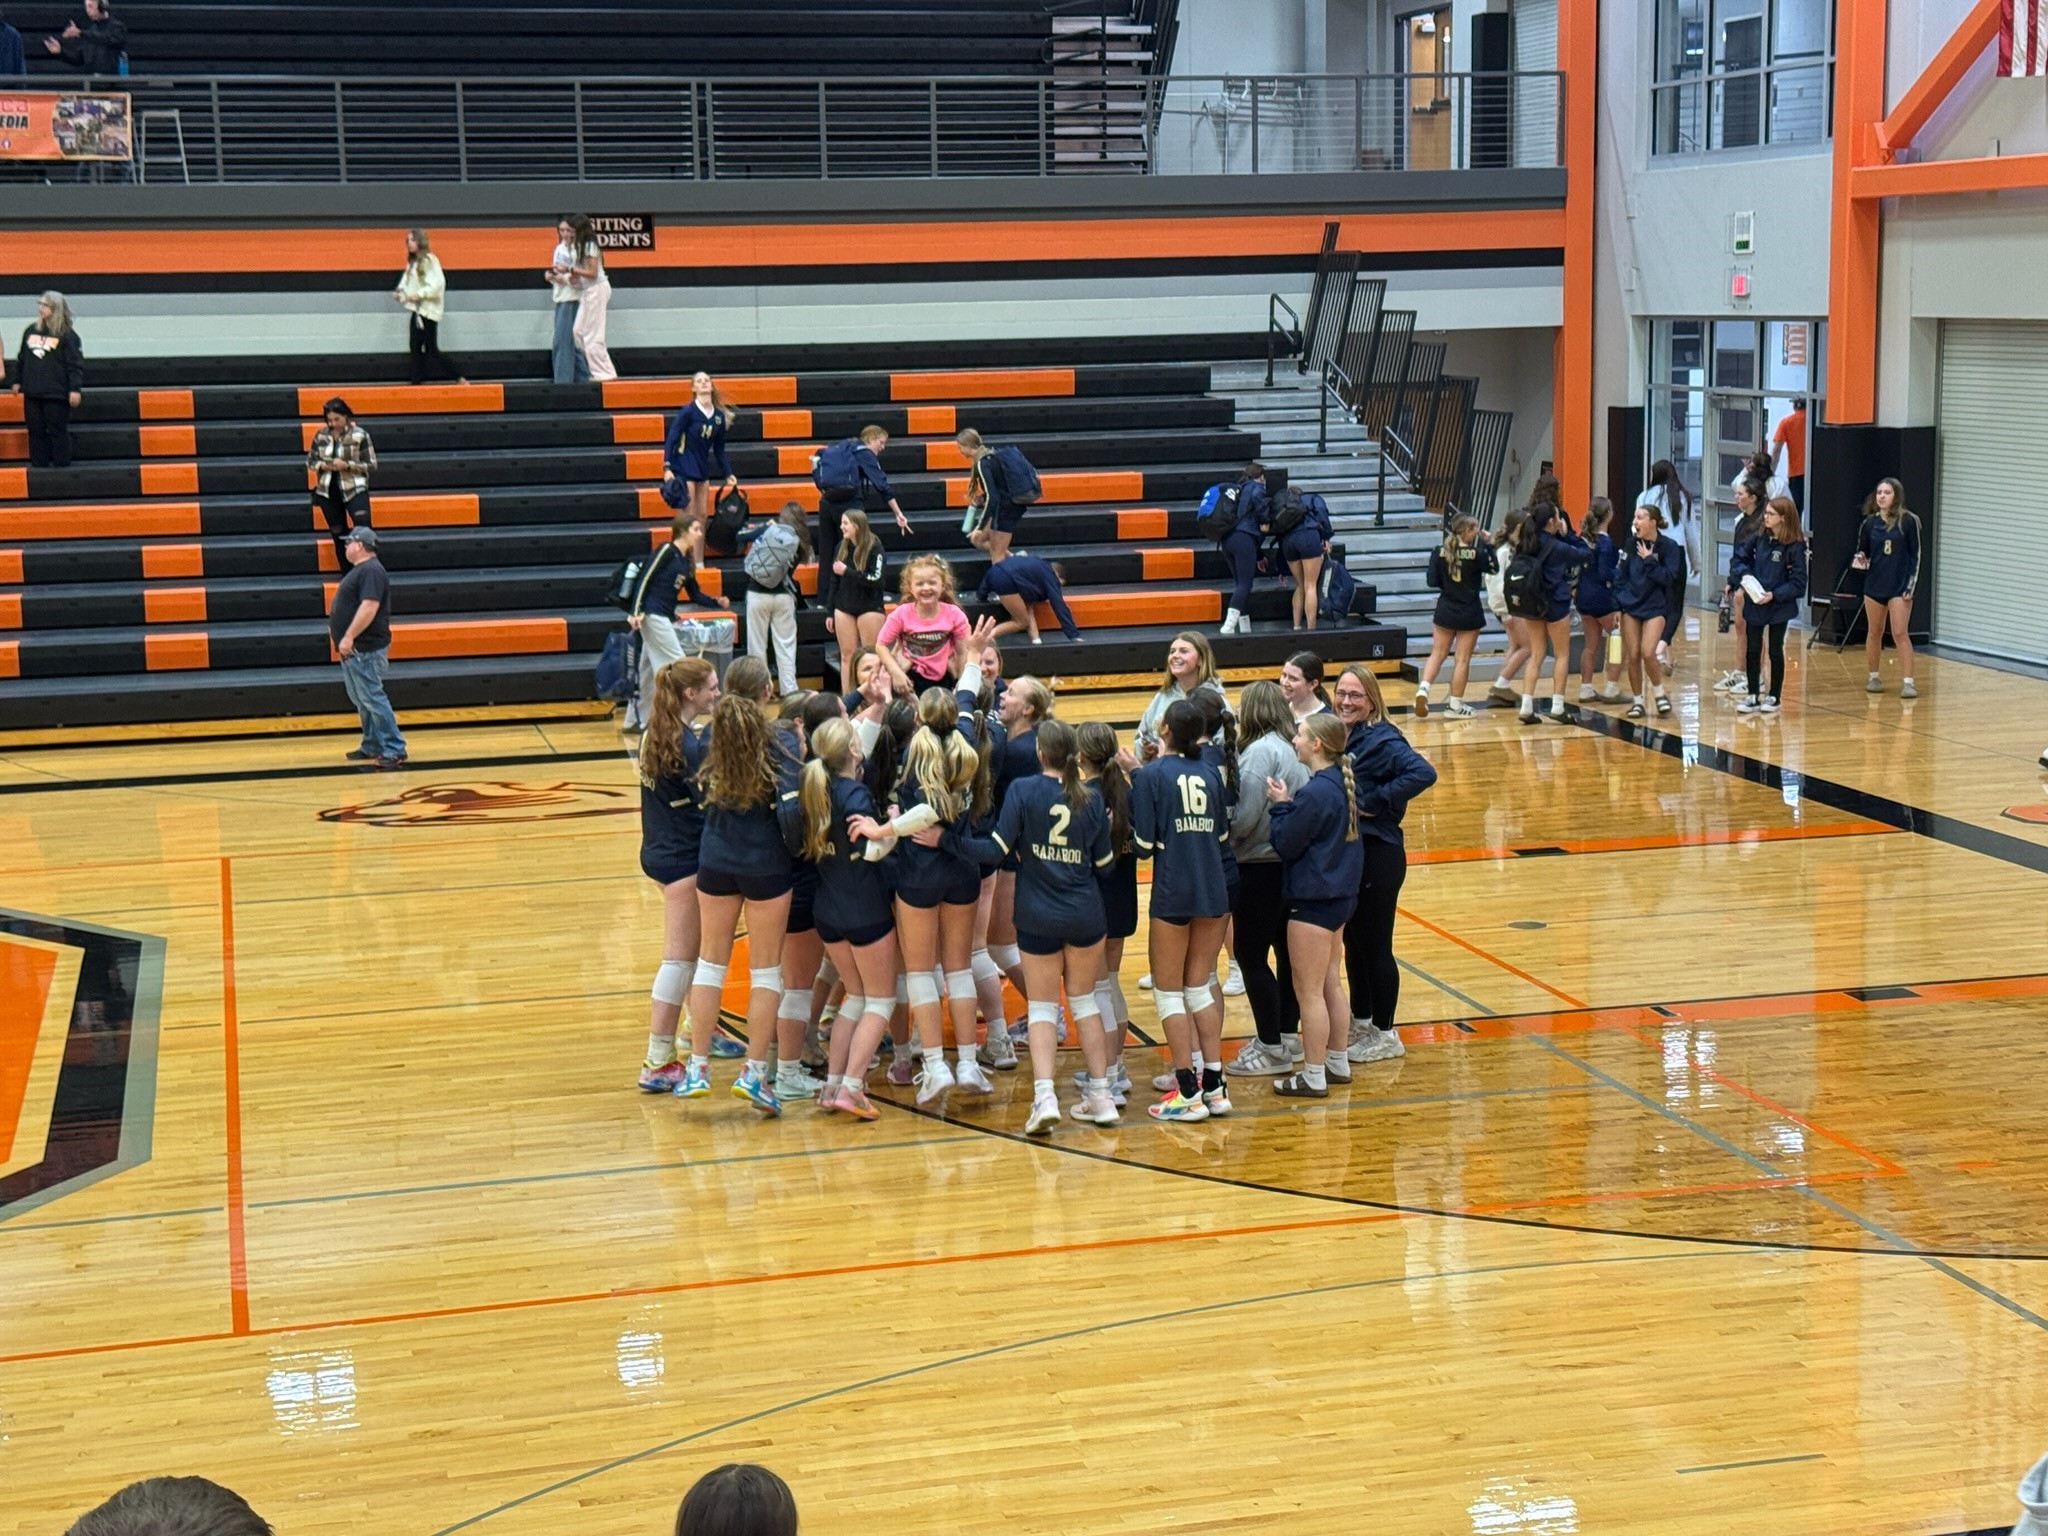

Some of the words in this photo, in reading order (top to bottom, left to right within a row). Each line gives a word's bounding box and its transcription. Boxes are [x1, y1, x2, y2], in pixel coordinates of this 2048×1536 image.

[0, 115, 28, 128] EDIA
[589, 217, 643, 231] SITING
[596, 232, 651, 247] DENTS
[1177, 774, 1207, 814] 16
[1049, 804, 1071, 846] 2
[1032, 843, 1082, 864] BARABOO
